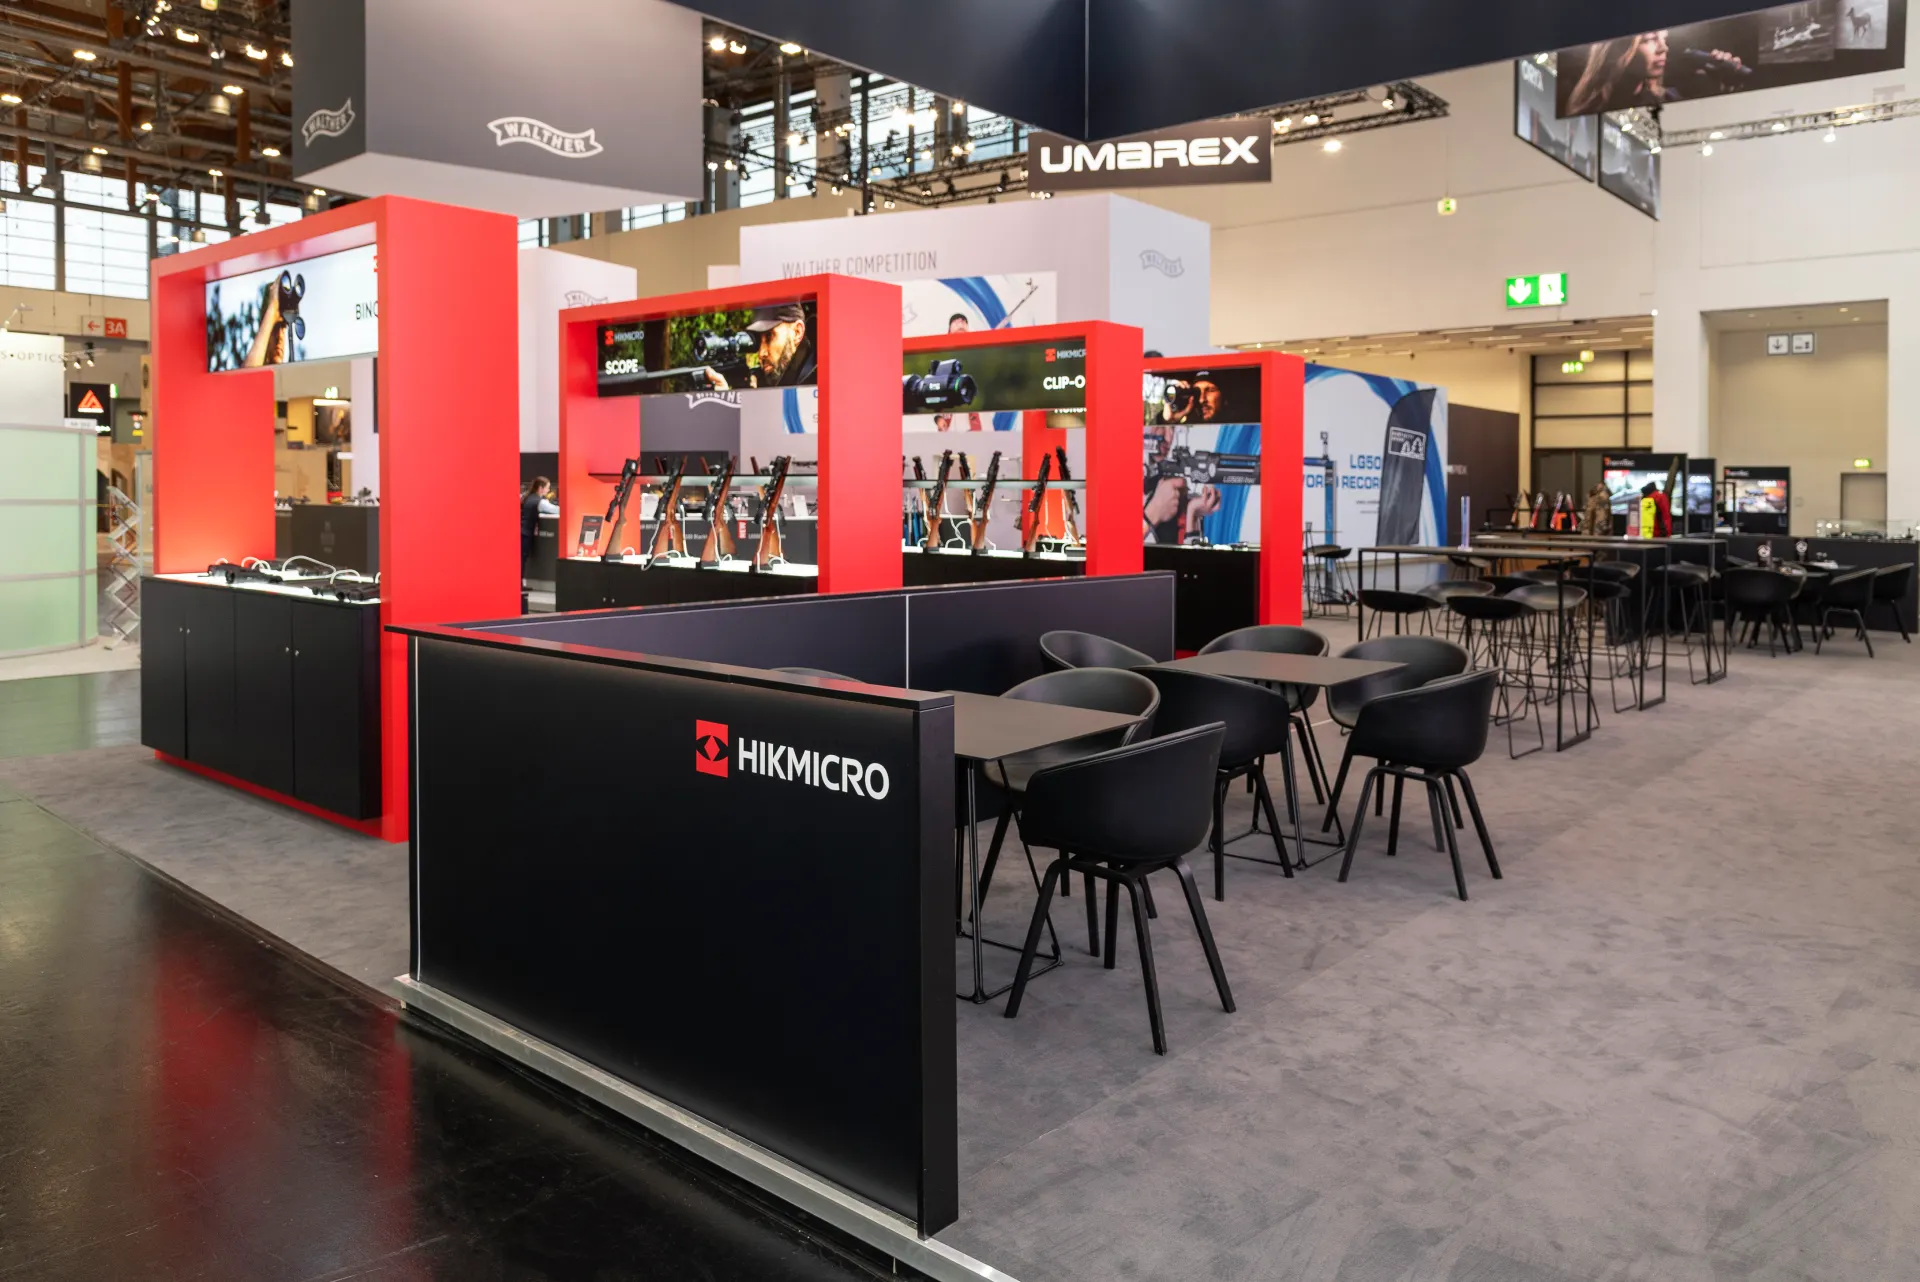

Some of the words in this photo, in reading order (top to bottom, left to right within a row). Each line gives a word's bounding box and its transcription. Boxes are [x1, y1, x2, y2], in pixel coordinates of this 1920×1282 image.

[503, 121, 586, 153] WALTHER
[1040, 136, 1260, 174] UMAREX
[846, 250, 938, 276] COMPETITION
[106, 321, 126, 335] 3A
[604, 358, 639, 375] SCOPE
[1042, 374, 1086, 390] CLIP-O
[738, 737, 890, 801] HIKMICRO
